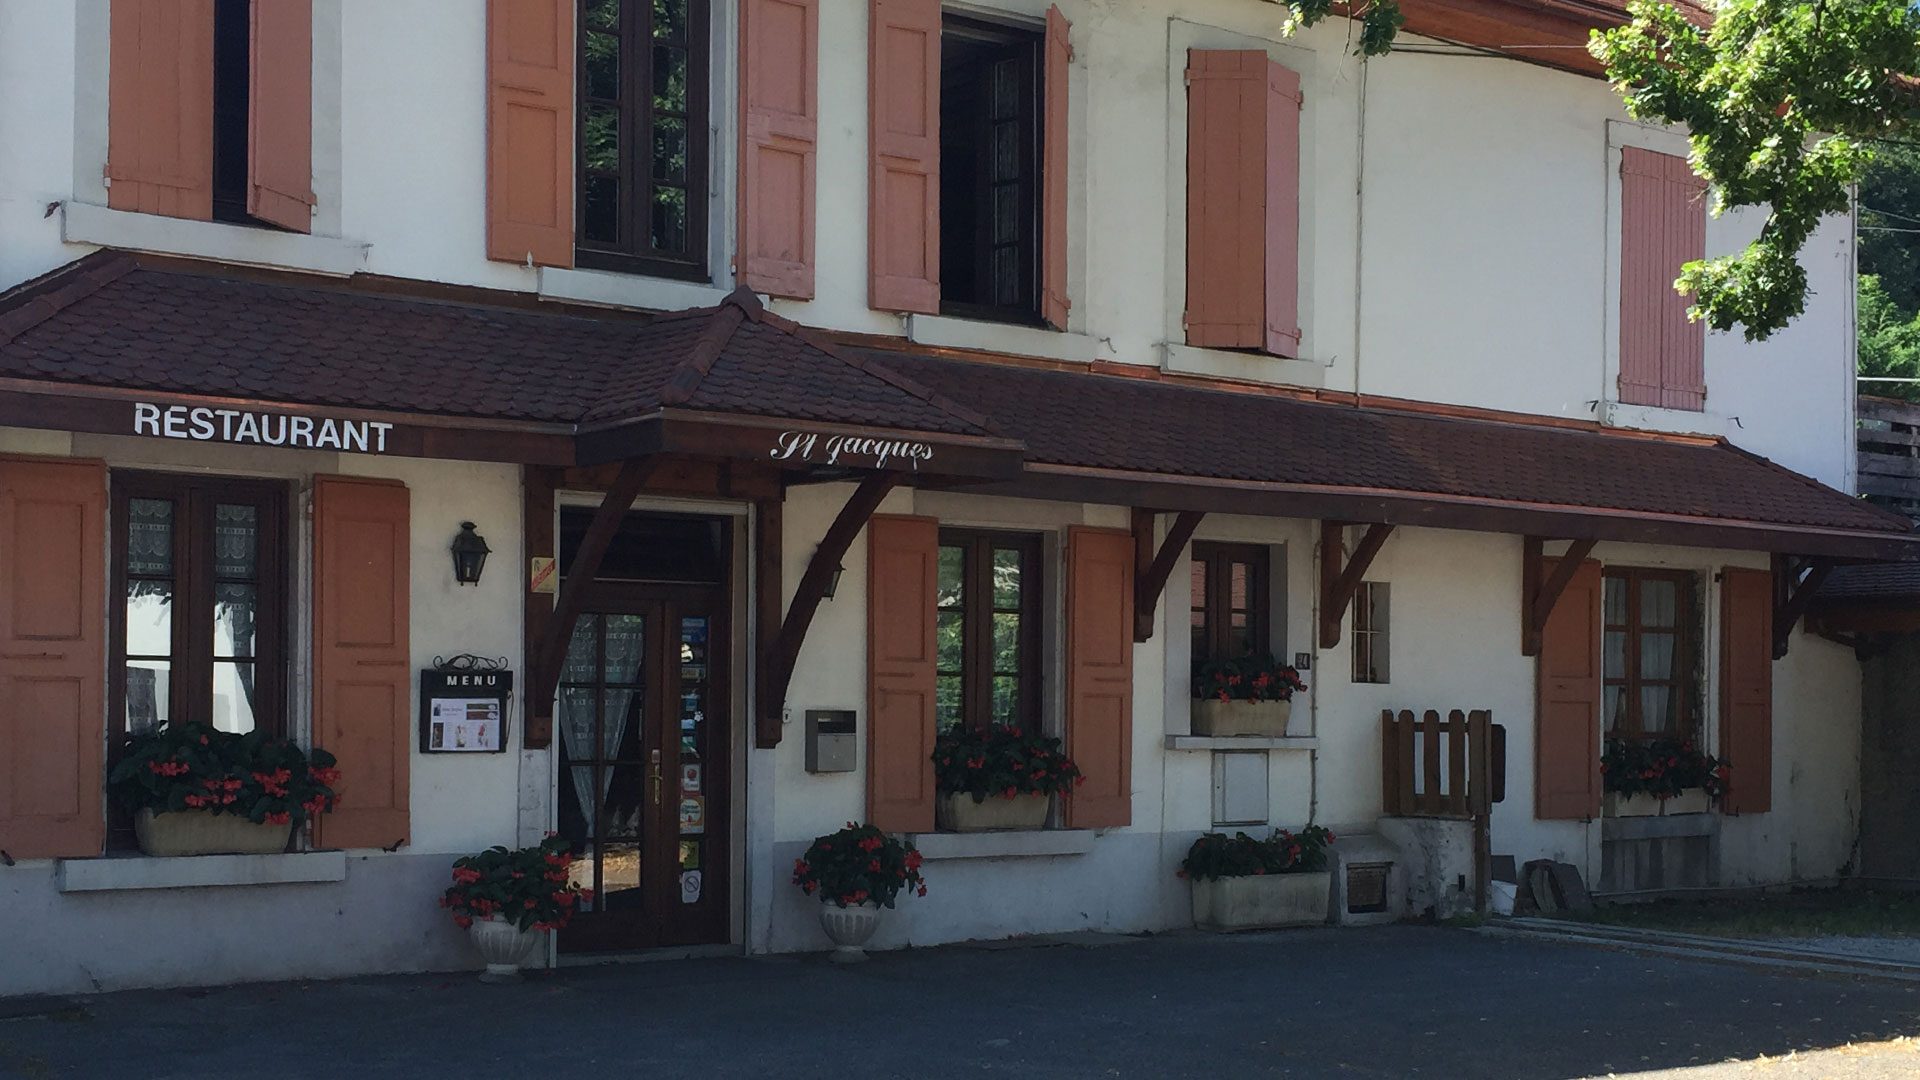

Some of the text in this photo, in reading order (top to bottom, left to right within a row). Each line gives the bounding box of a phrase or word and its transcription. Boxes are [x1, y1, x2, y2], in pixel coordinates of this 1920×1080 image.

[134, 402, 393, 452] RESTAURANT
[770, 431, 935, 470] St Jacques
[446, 675, 496, 686] MENU
